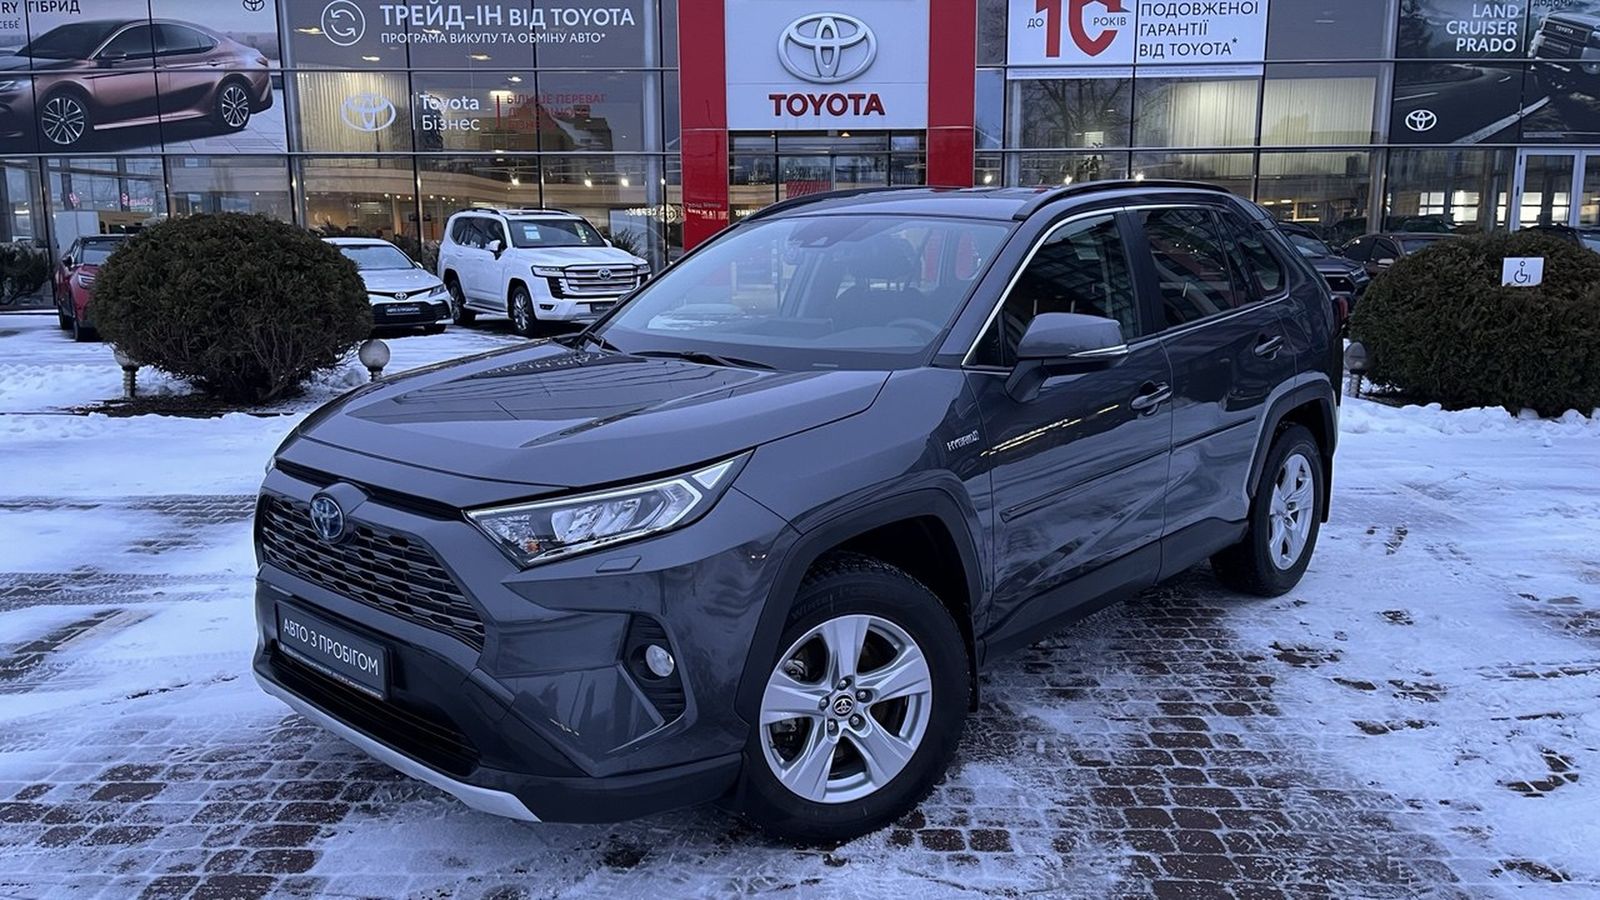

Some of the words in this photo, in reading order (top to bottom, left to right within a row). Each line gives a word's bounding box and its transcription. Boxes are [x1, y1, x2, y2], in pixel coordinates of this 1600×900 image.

[28, 0, 81, 15] ГІБРИД
[379, 0, 502, 30] ТРЕЙД-ІН
[509, 8, 546, 30] ВІД
[550, 8, 636, 26] TOYOTA
[1472, 4, 1519, 18] LAND
[1027, 18, 1044, 29] ДО
[1093, 17, 1127, 26] РОКІВ
[1140, 19, 1209, 36] ГАРАНТІЇ
[1446, 20, 1517, 35] CRUISER
[381, 33, 447, 43] ПРОГРАМА
[450, 33, 499, 43] ВИКУПУ
[501, 33, 516, 43] ТА
[518, 33, 567, 43] ОБМІНУ
[1456, 37, 1517, 52] PRADO
[1140, 43, 1165, 59] ВІД
[419, 94, 480, 113] Toyota
[768, 93, 885, 117] TOYOTA
[422, 114, 480, 131] Бізнес
[283, 618, 308, 643] АВТО
[319, 634, 379, 676] ПРОБІГОМ
